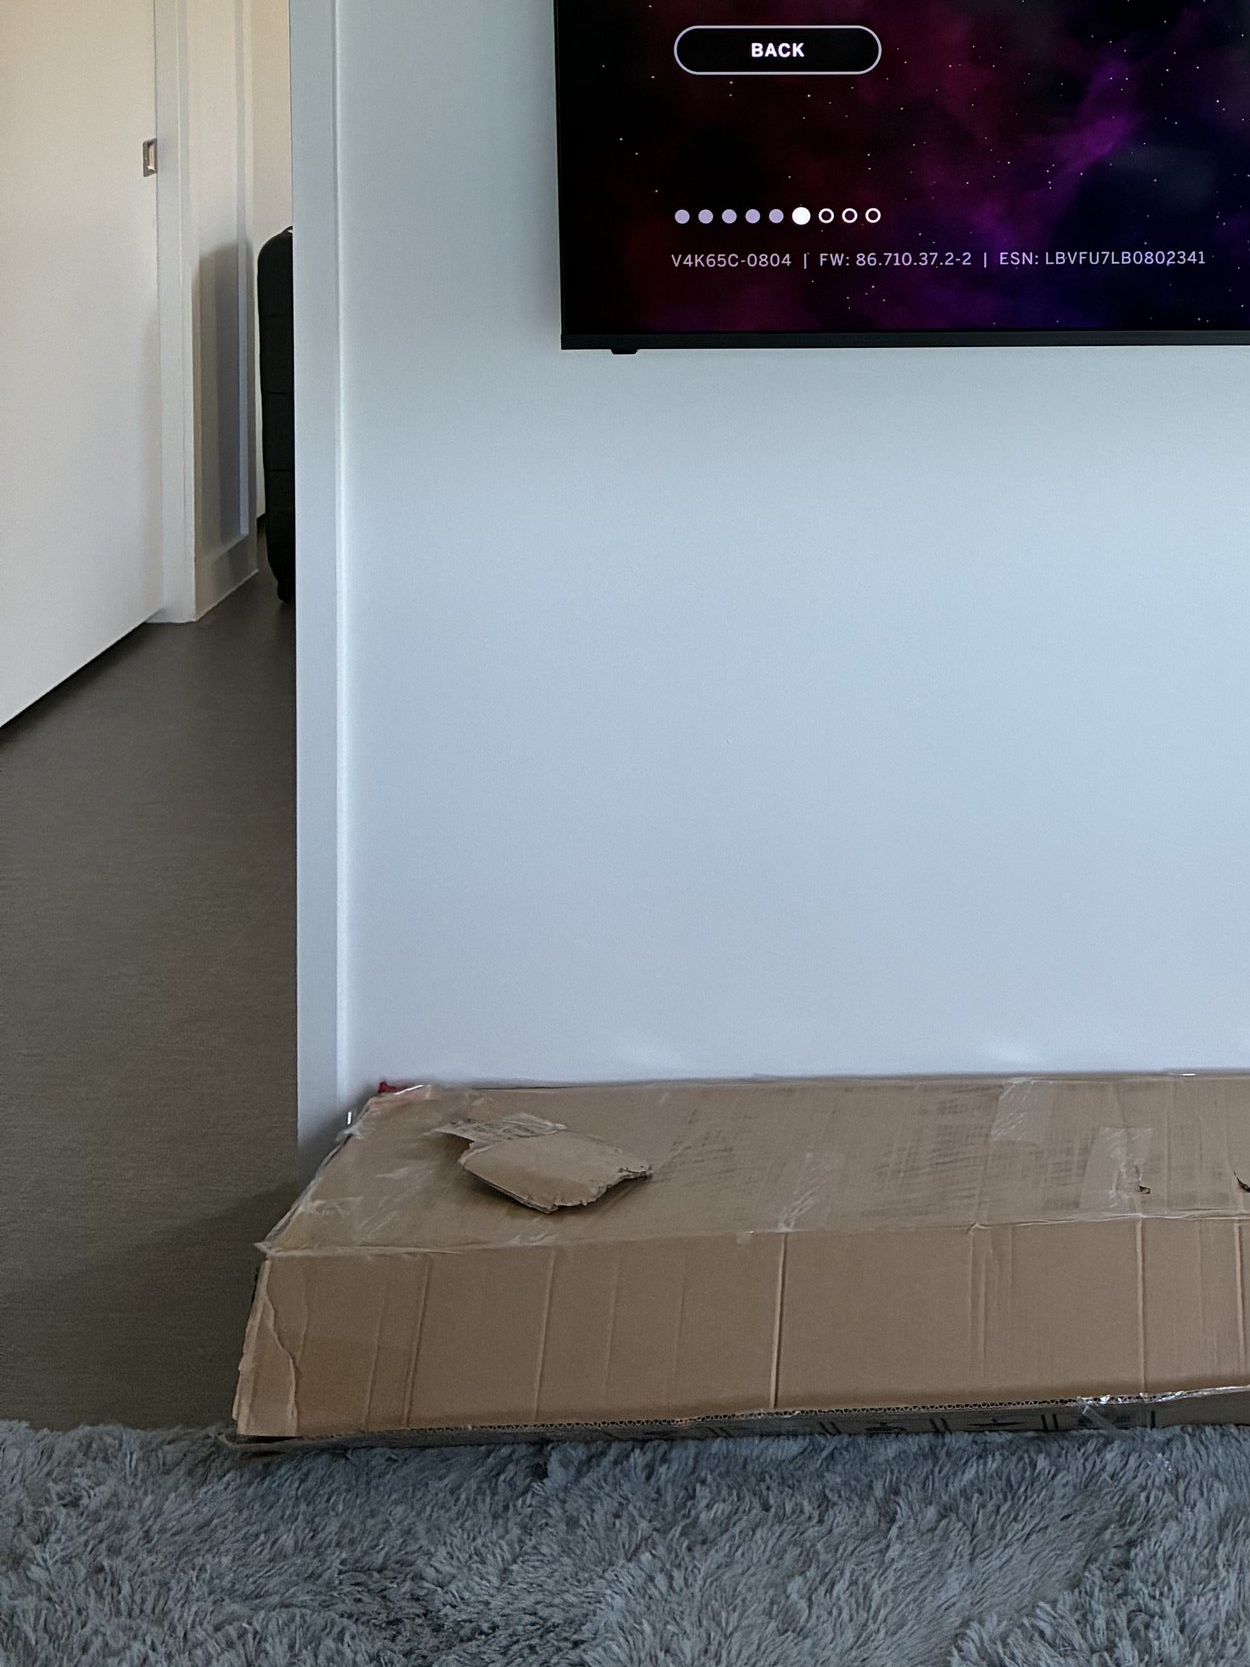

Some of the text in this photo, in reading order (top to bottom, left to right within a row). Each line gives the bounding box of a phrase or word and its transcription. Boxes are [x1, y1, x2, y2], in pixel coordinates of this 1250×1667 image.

[752, 43, 804, 57] BACK
[672, 254, 791, 267] V4K65C-0804
[820, 254, 849, 266] FW:
[856, 252, 971, 268] 86.710.37.2-2
[1000, 252, 1038, 268] ESN:
